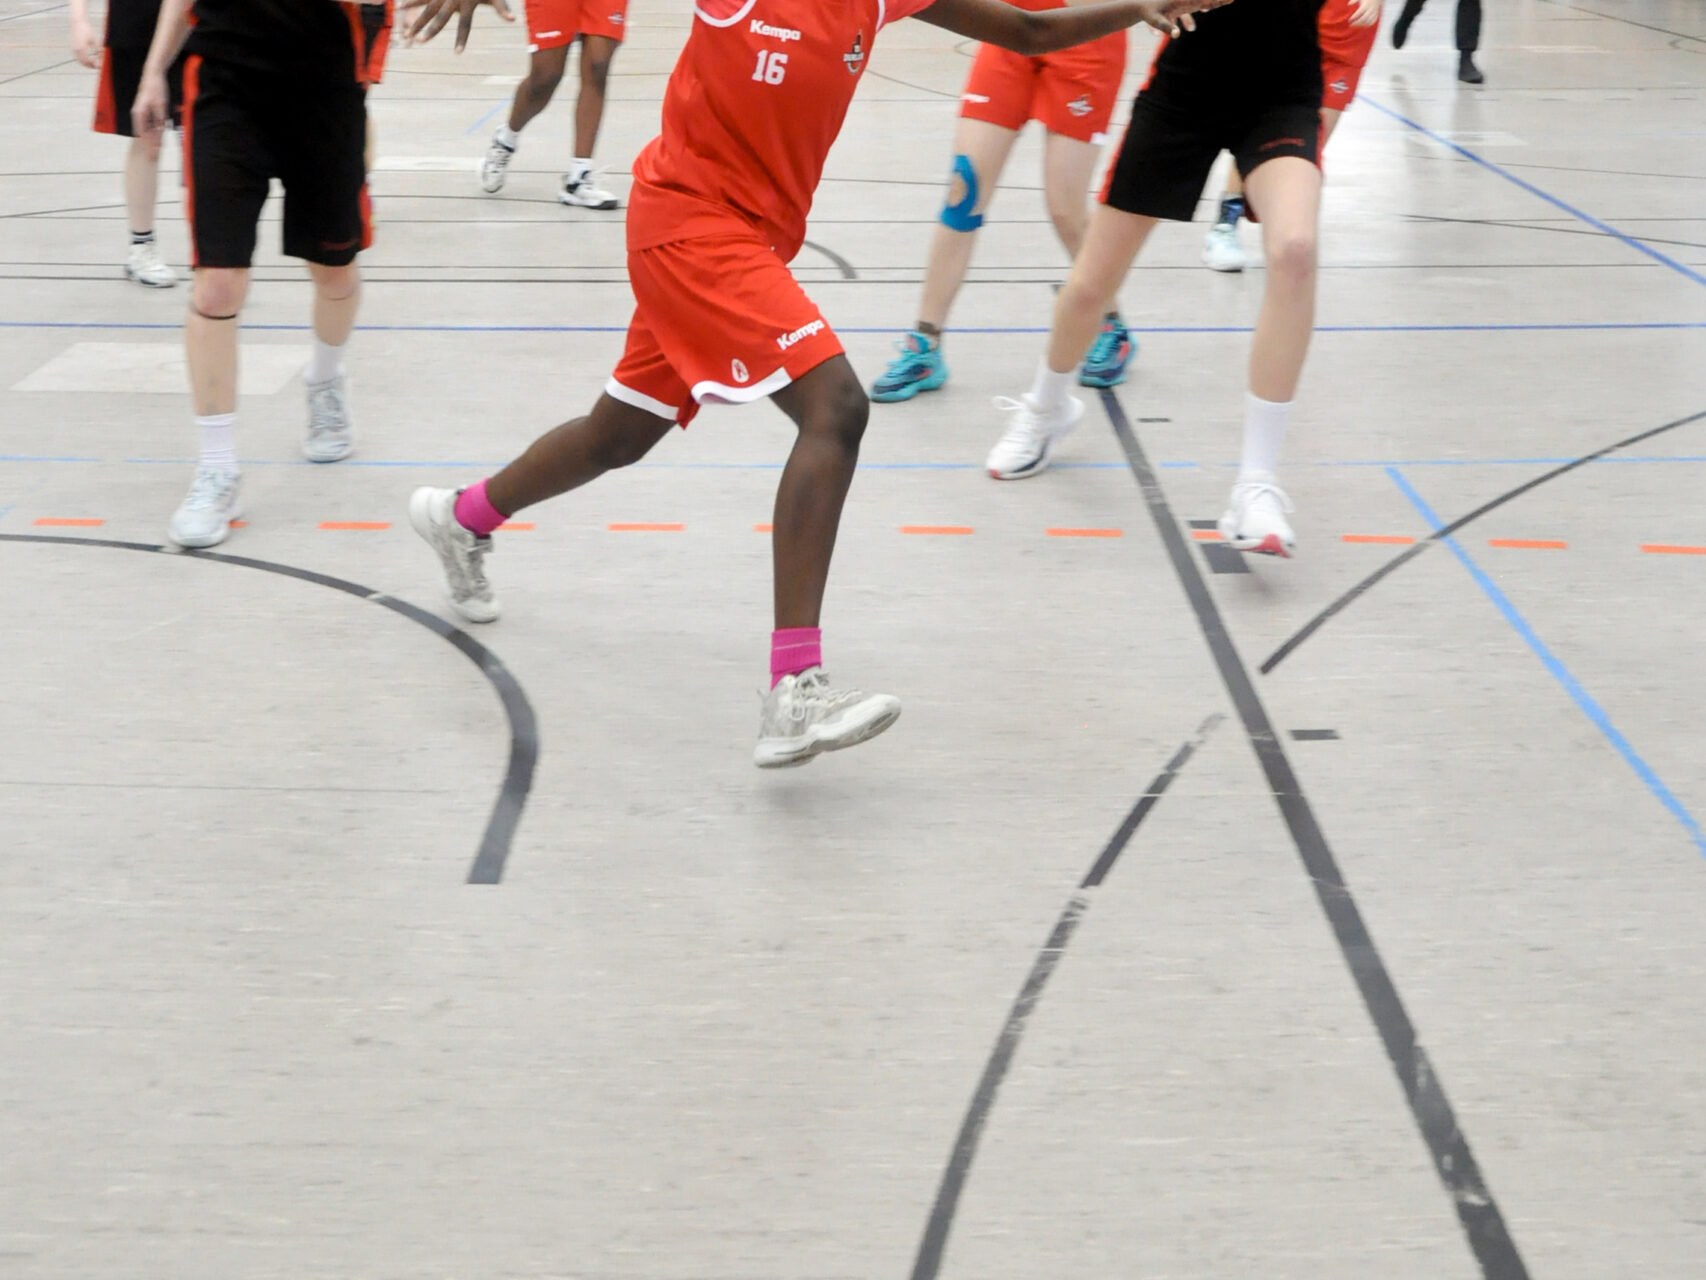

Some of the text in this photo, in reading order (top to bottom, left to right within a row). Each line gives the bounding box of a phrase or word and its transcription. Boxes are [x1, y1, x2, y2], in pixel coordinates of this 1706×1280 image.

[750, 19, 801, 41] Kempa
[752, 49, 788, 85] 16
[776, 319, 825, 350] Kempa
